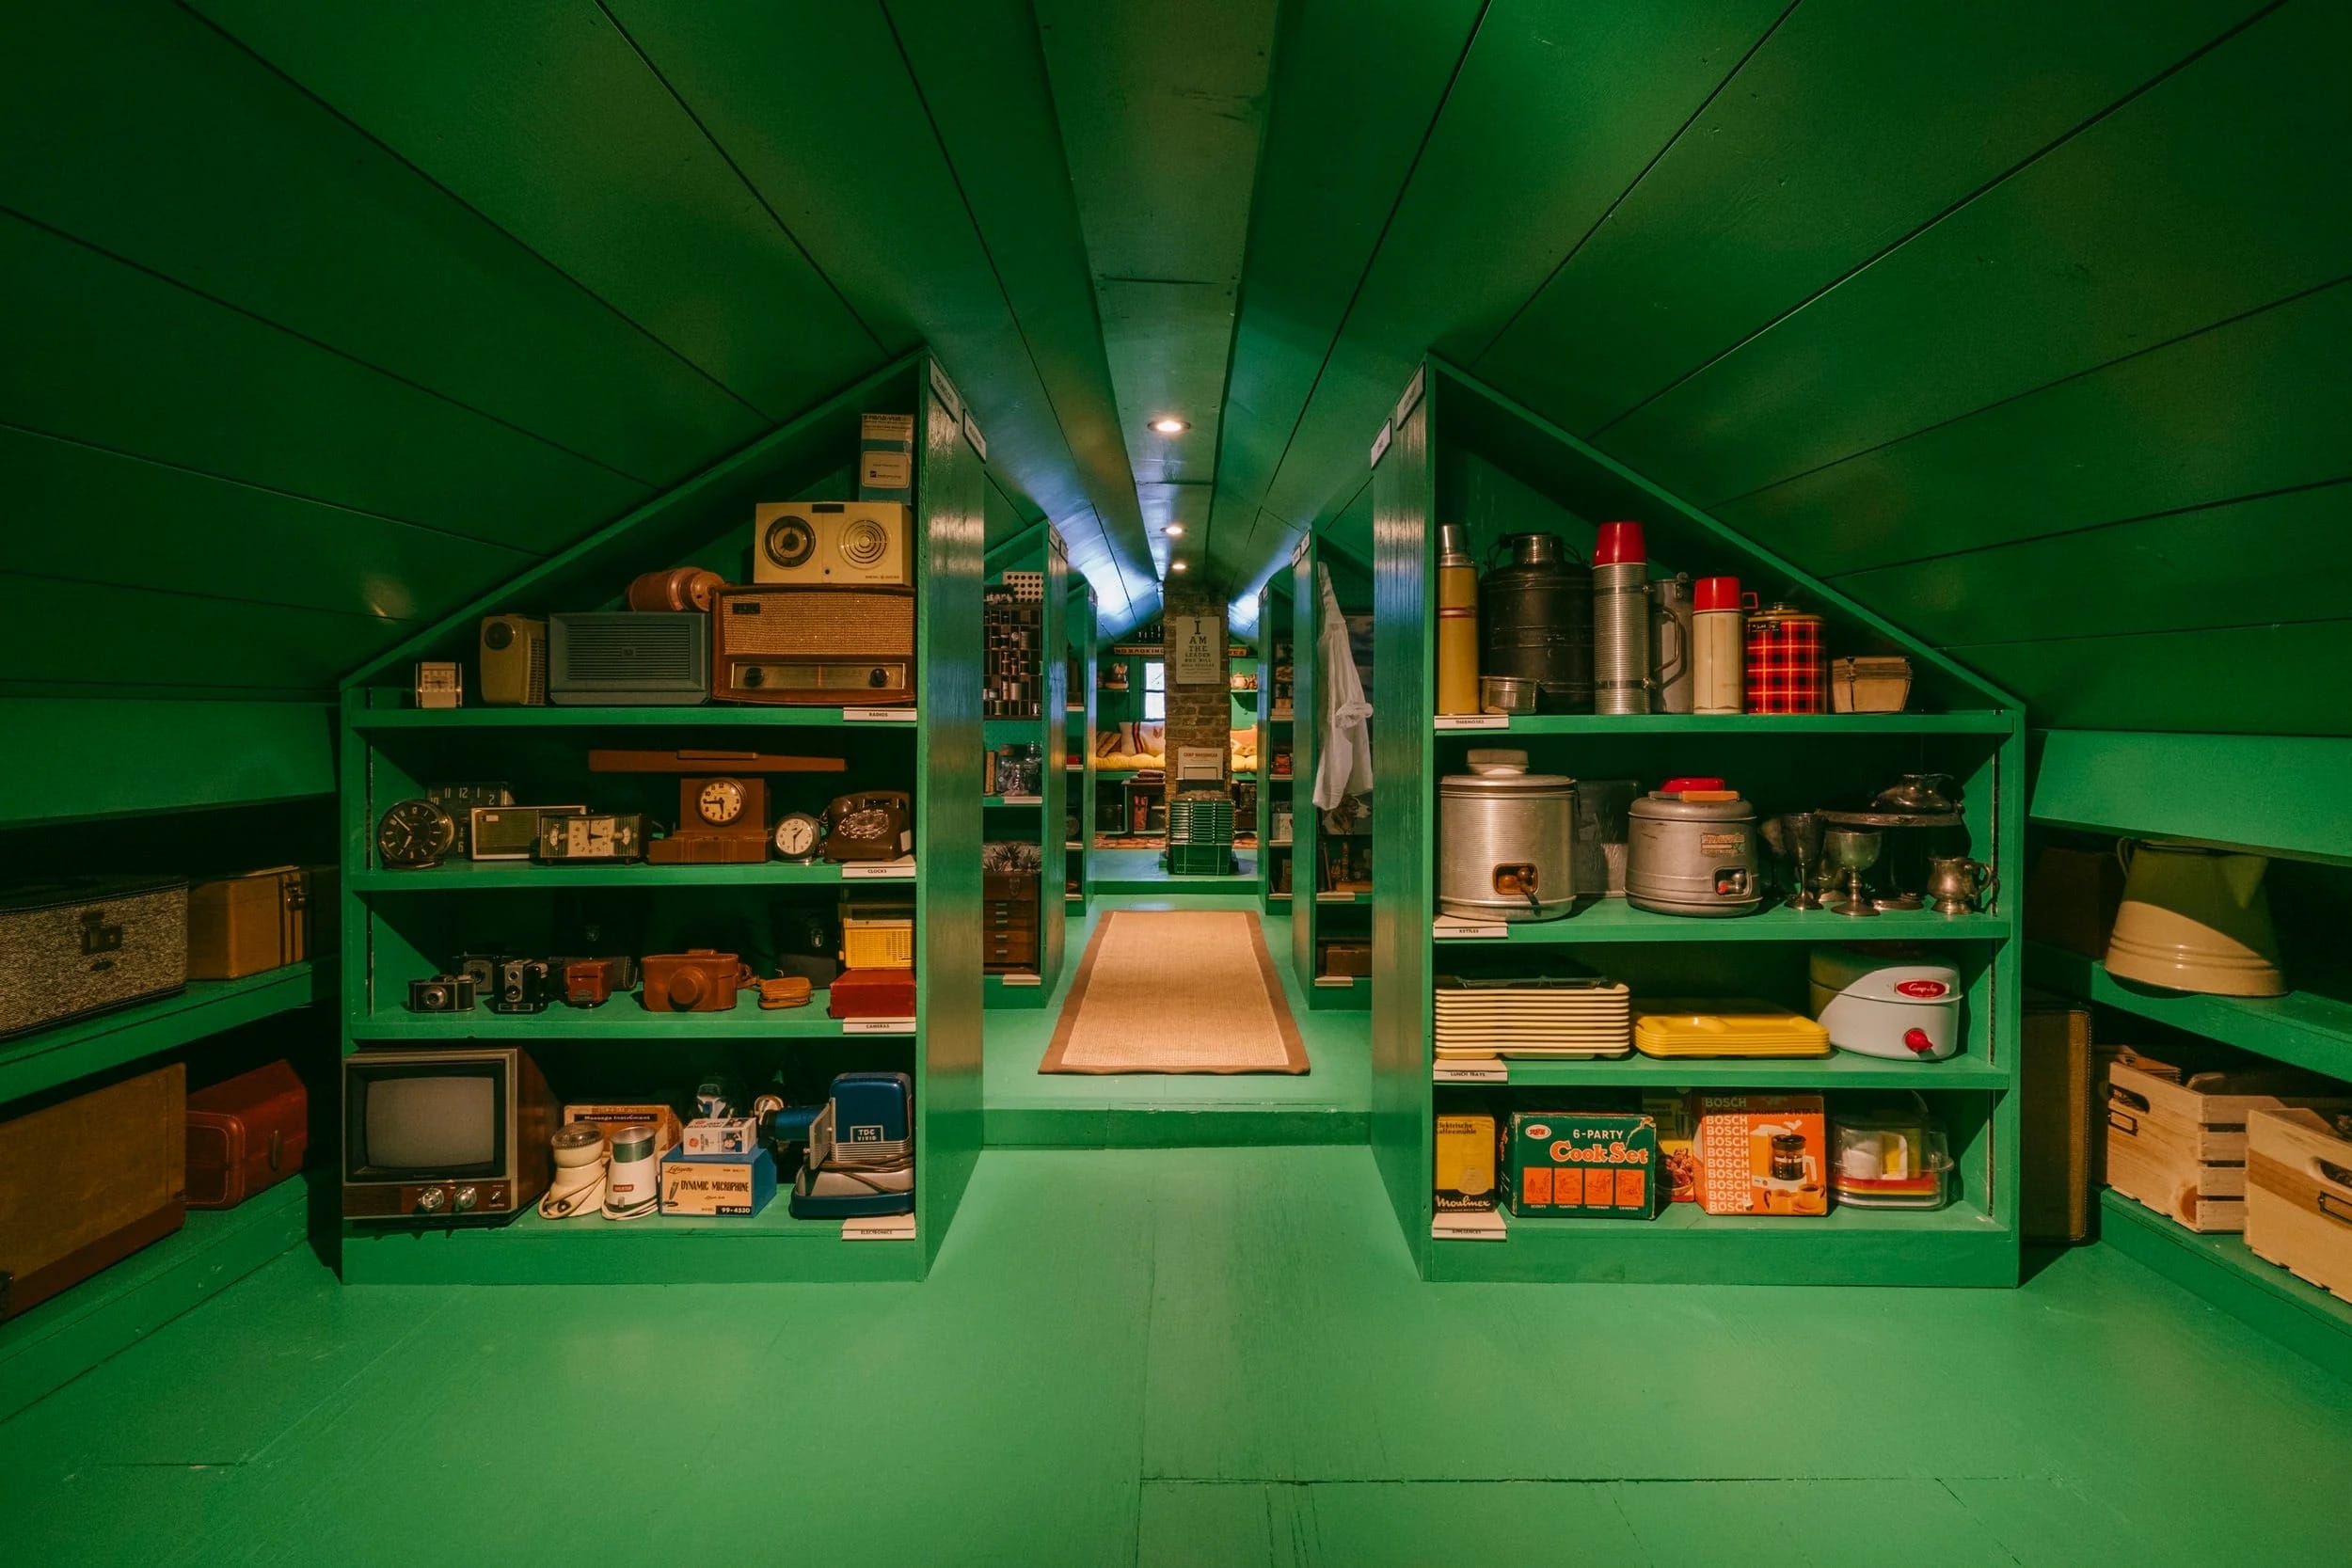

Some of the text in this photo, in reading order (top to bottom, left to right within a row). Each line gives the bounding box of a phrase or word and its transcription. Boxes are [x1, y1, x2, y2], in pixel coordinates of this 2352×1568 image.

[1194, 621, 1201, 635] I
[1189, 636, 1207, 644] AM
[1705, 1097, 1747, 1107] BOSCH
[1706, 1116, 1748, 1125] BOSCH
[1572, 1129, 1624, 1139] 6-PARTY
[1706, 1126, 1748, 1135] BOSCH
[1707, 1136, 1749, 1147] BOSCH
[1549, 1140, 1649, 1164] Cook Set
[1707, 1148, 1749, 1157] BOSCH
[1708, 1158, 1750, 1168] BOSCH
[1708, 1169, 1751, 1179] BOSCH
[680, 1180, 750, 1193] DYNAMIC MICROPHONE
[1708, 1180, 1751, 1190] BOSCH
[1708, 1191, 1751, 1200] BOSCH
[1435, 1195, 1491, 1207] Moulinex
[1709, 1201, 1745, 1212] BOSC
